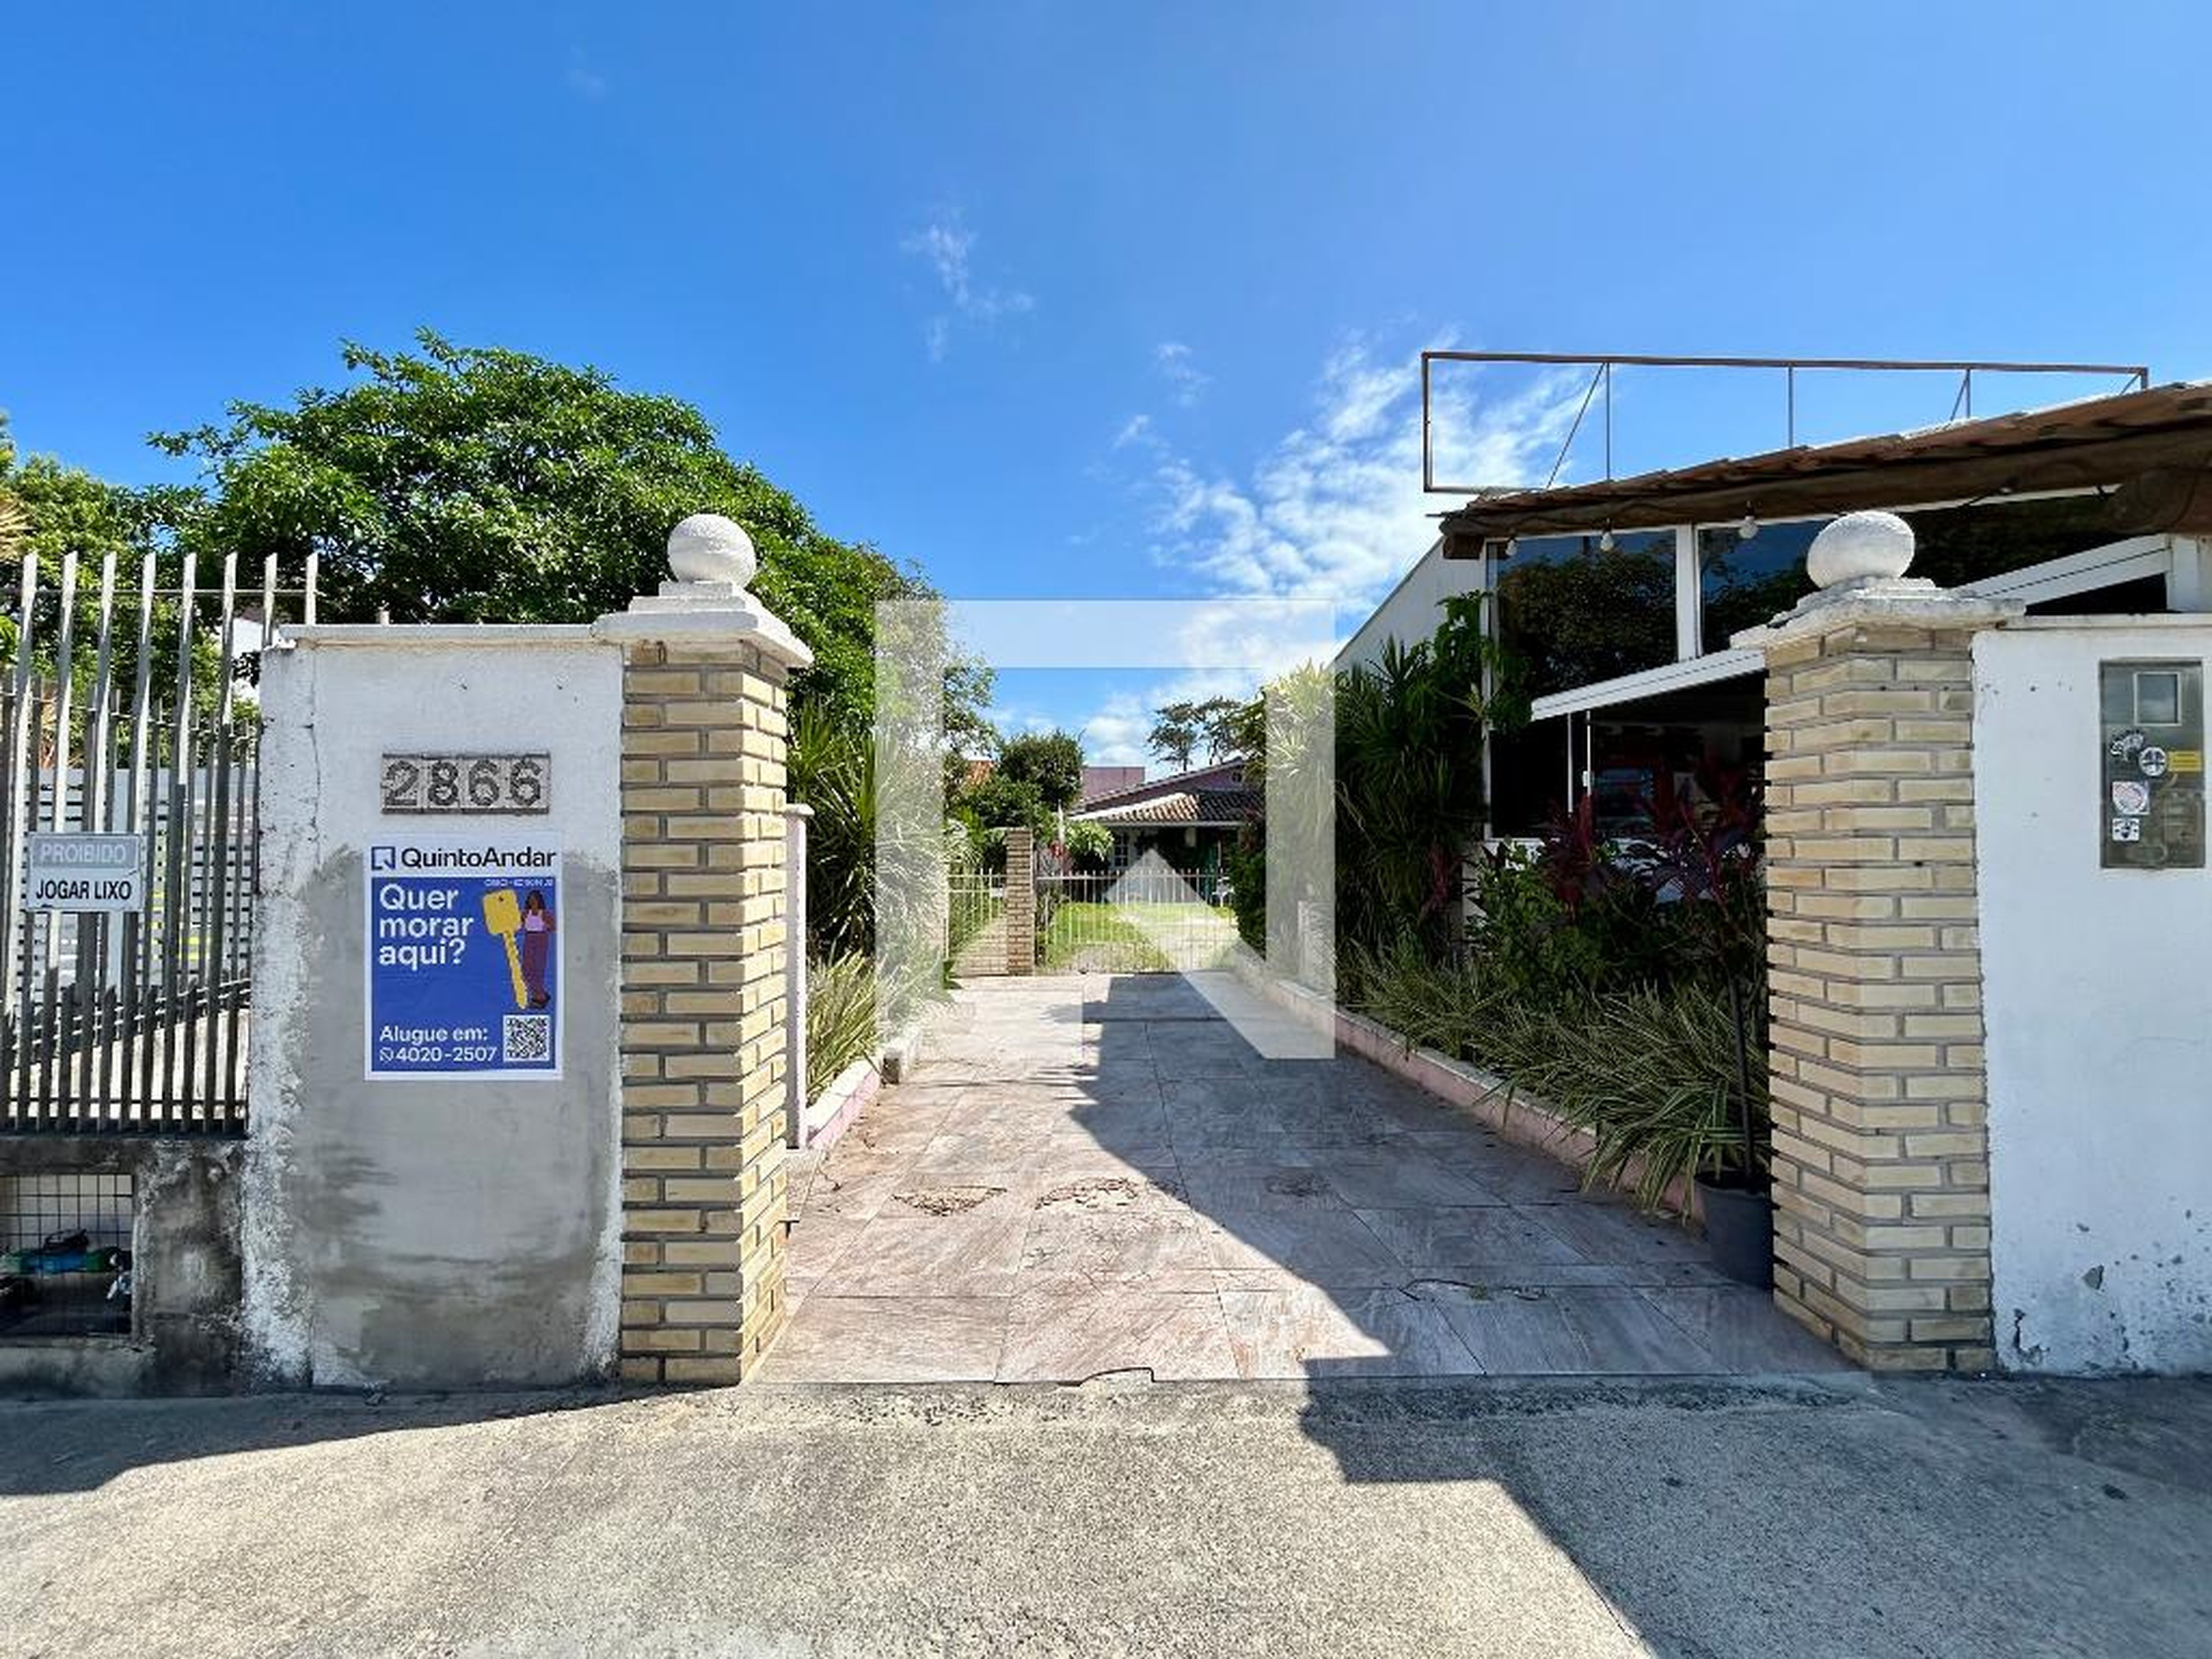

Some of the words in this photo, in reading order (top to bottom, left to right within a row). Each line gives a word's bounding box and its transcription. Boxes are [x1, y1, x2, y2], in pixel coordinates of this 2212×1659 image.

[384, 760, 542, 806] 2866
[40, 843, 127, 863] PROIBIDO
[401, 846, 556, 869] QuintoAndar
[36, 879, 90, 900] JOGAR
[94, 880, 132, 900] LIXO
[379, 883, 459, 911] Quer
[379, 916, 474, 938] morar
[379, 937, 466, 970] aqui?
[379, 1026, 448, 1046] Alugue
[452, 1028, 488, 1041] em:
[395, 1047, 498, 1062] 4020-2507
